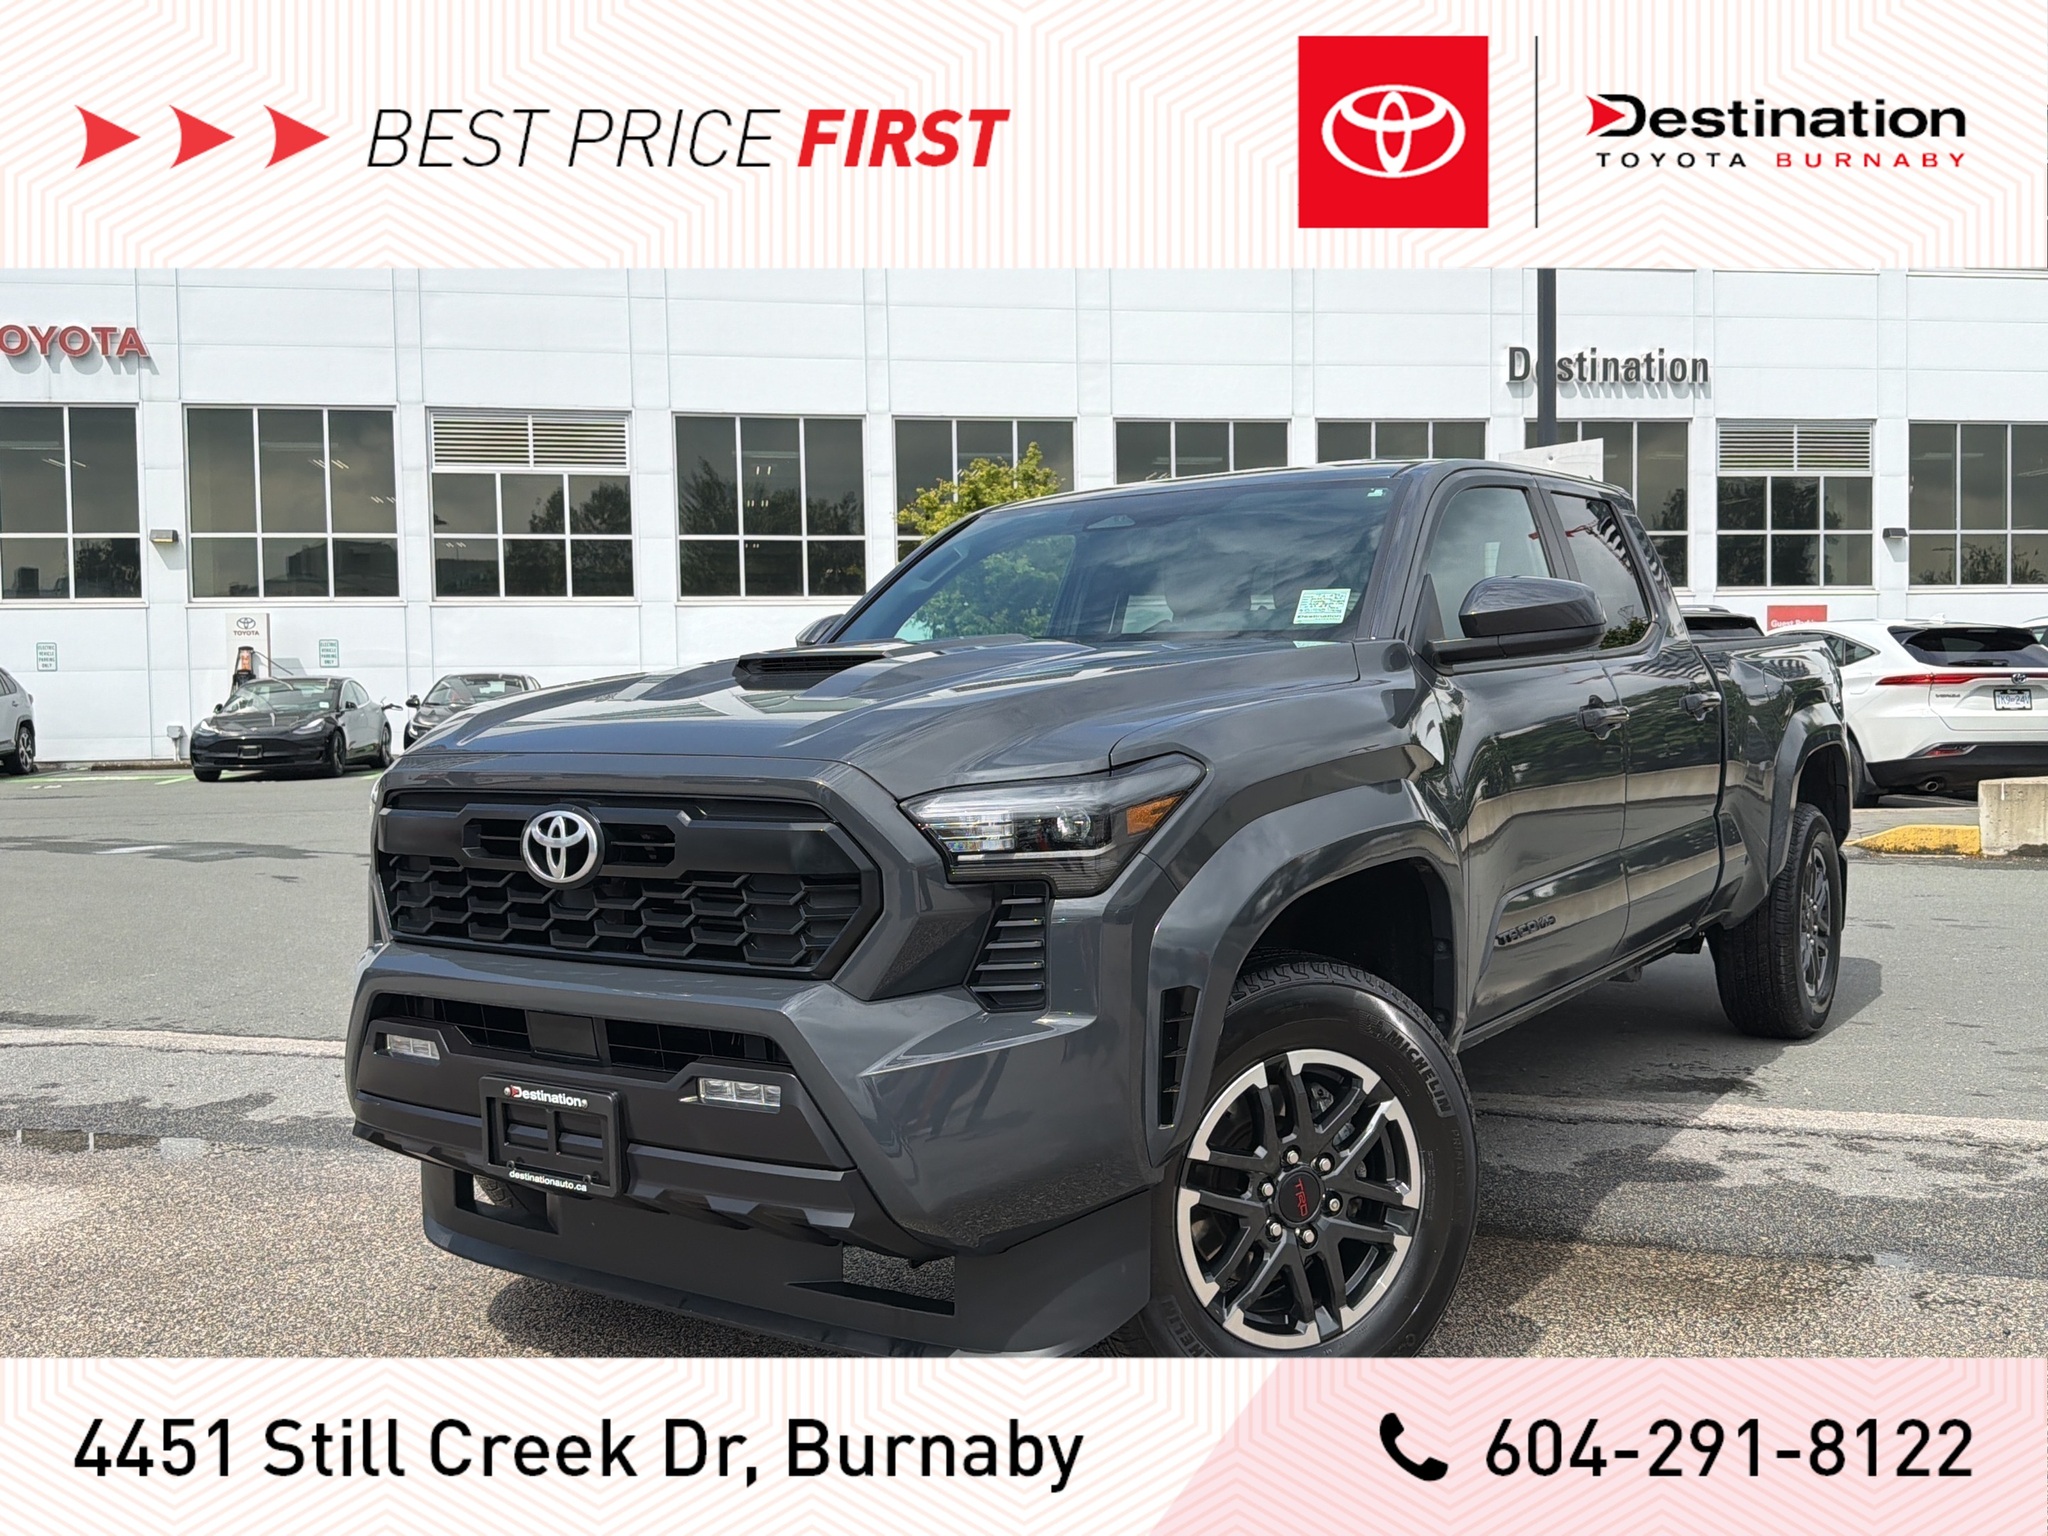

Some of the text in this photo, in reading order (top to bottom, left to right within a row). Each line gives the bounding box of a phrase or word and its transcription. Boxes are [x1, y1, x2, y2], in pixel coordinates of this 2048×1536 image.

[1508, 347, 1709, 382] Dstination
[1385, 1030, 1452, 1113] MICHELIN
[511, 1085, 581, 1107] Destination
[509, 1170, 587, 1192] destinationauto.ca
[1294, 1178, 1308, 1216] TRD
